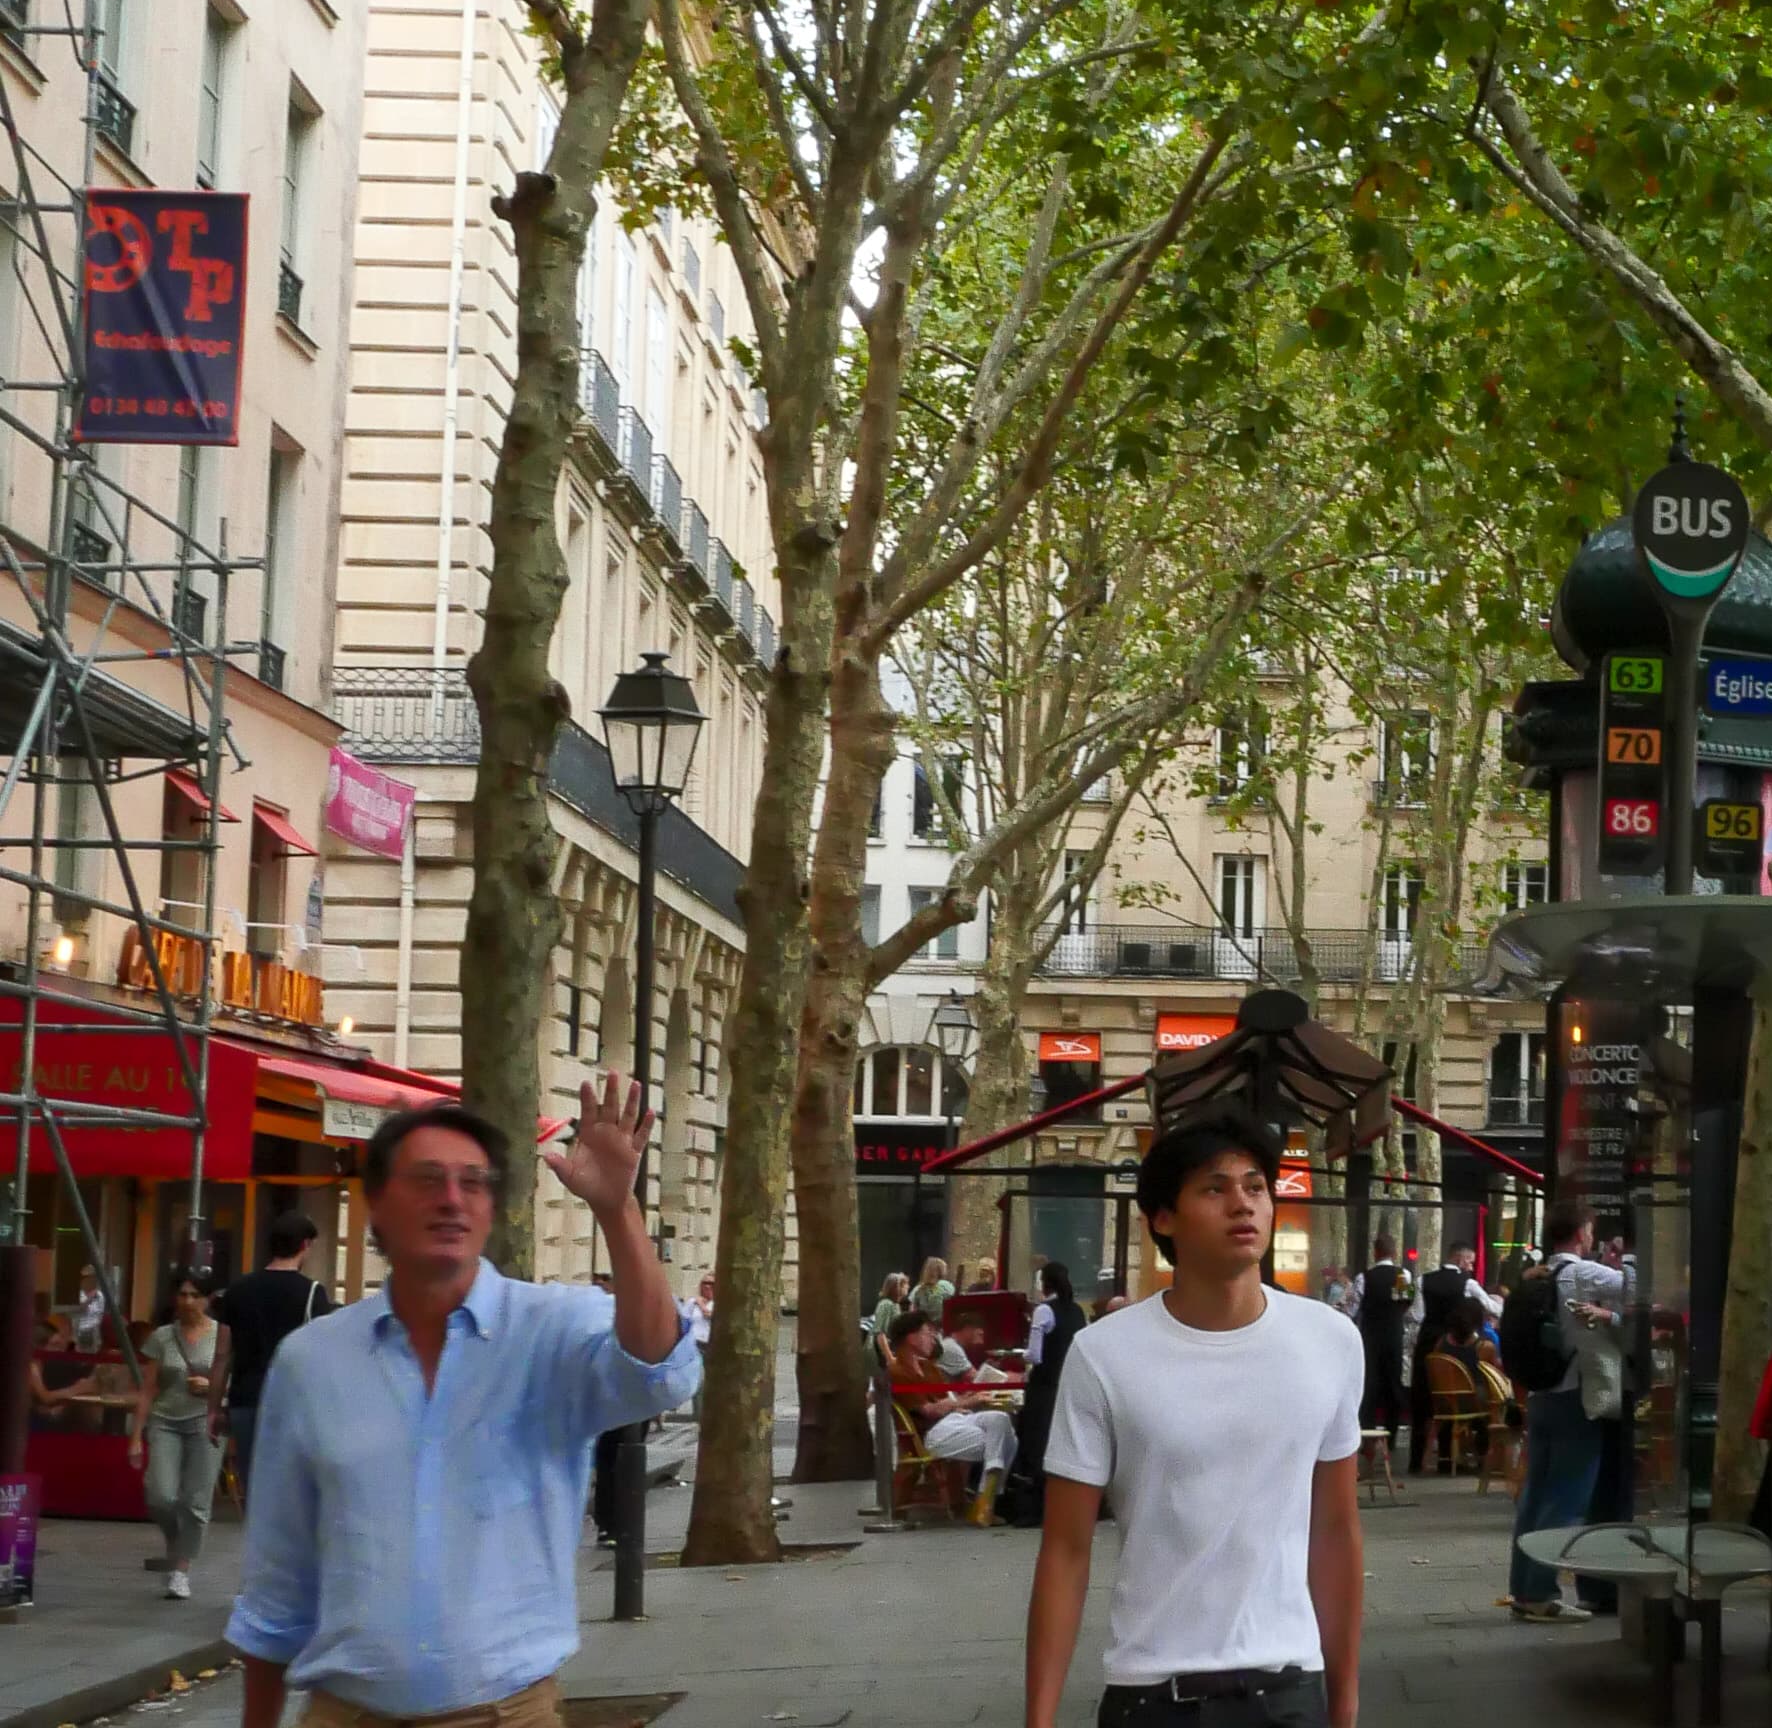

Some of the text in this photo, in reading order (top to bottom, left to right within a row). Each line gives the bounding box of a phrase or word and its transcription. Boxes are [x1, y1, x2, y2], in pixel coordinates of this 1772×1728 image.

[1652, 495, 1732, 538] BUS
[1616, 661, 1654, 688] 63
[1615, 733, 1654, 760] 70
[1611, 805, 1652, 833] 86
[1713, 807, 1753, 836] 96
[1160, 1033, 1210, 1046] DAVID
[104, 1066, 148, 1093] AU
